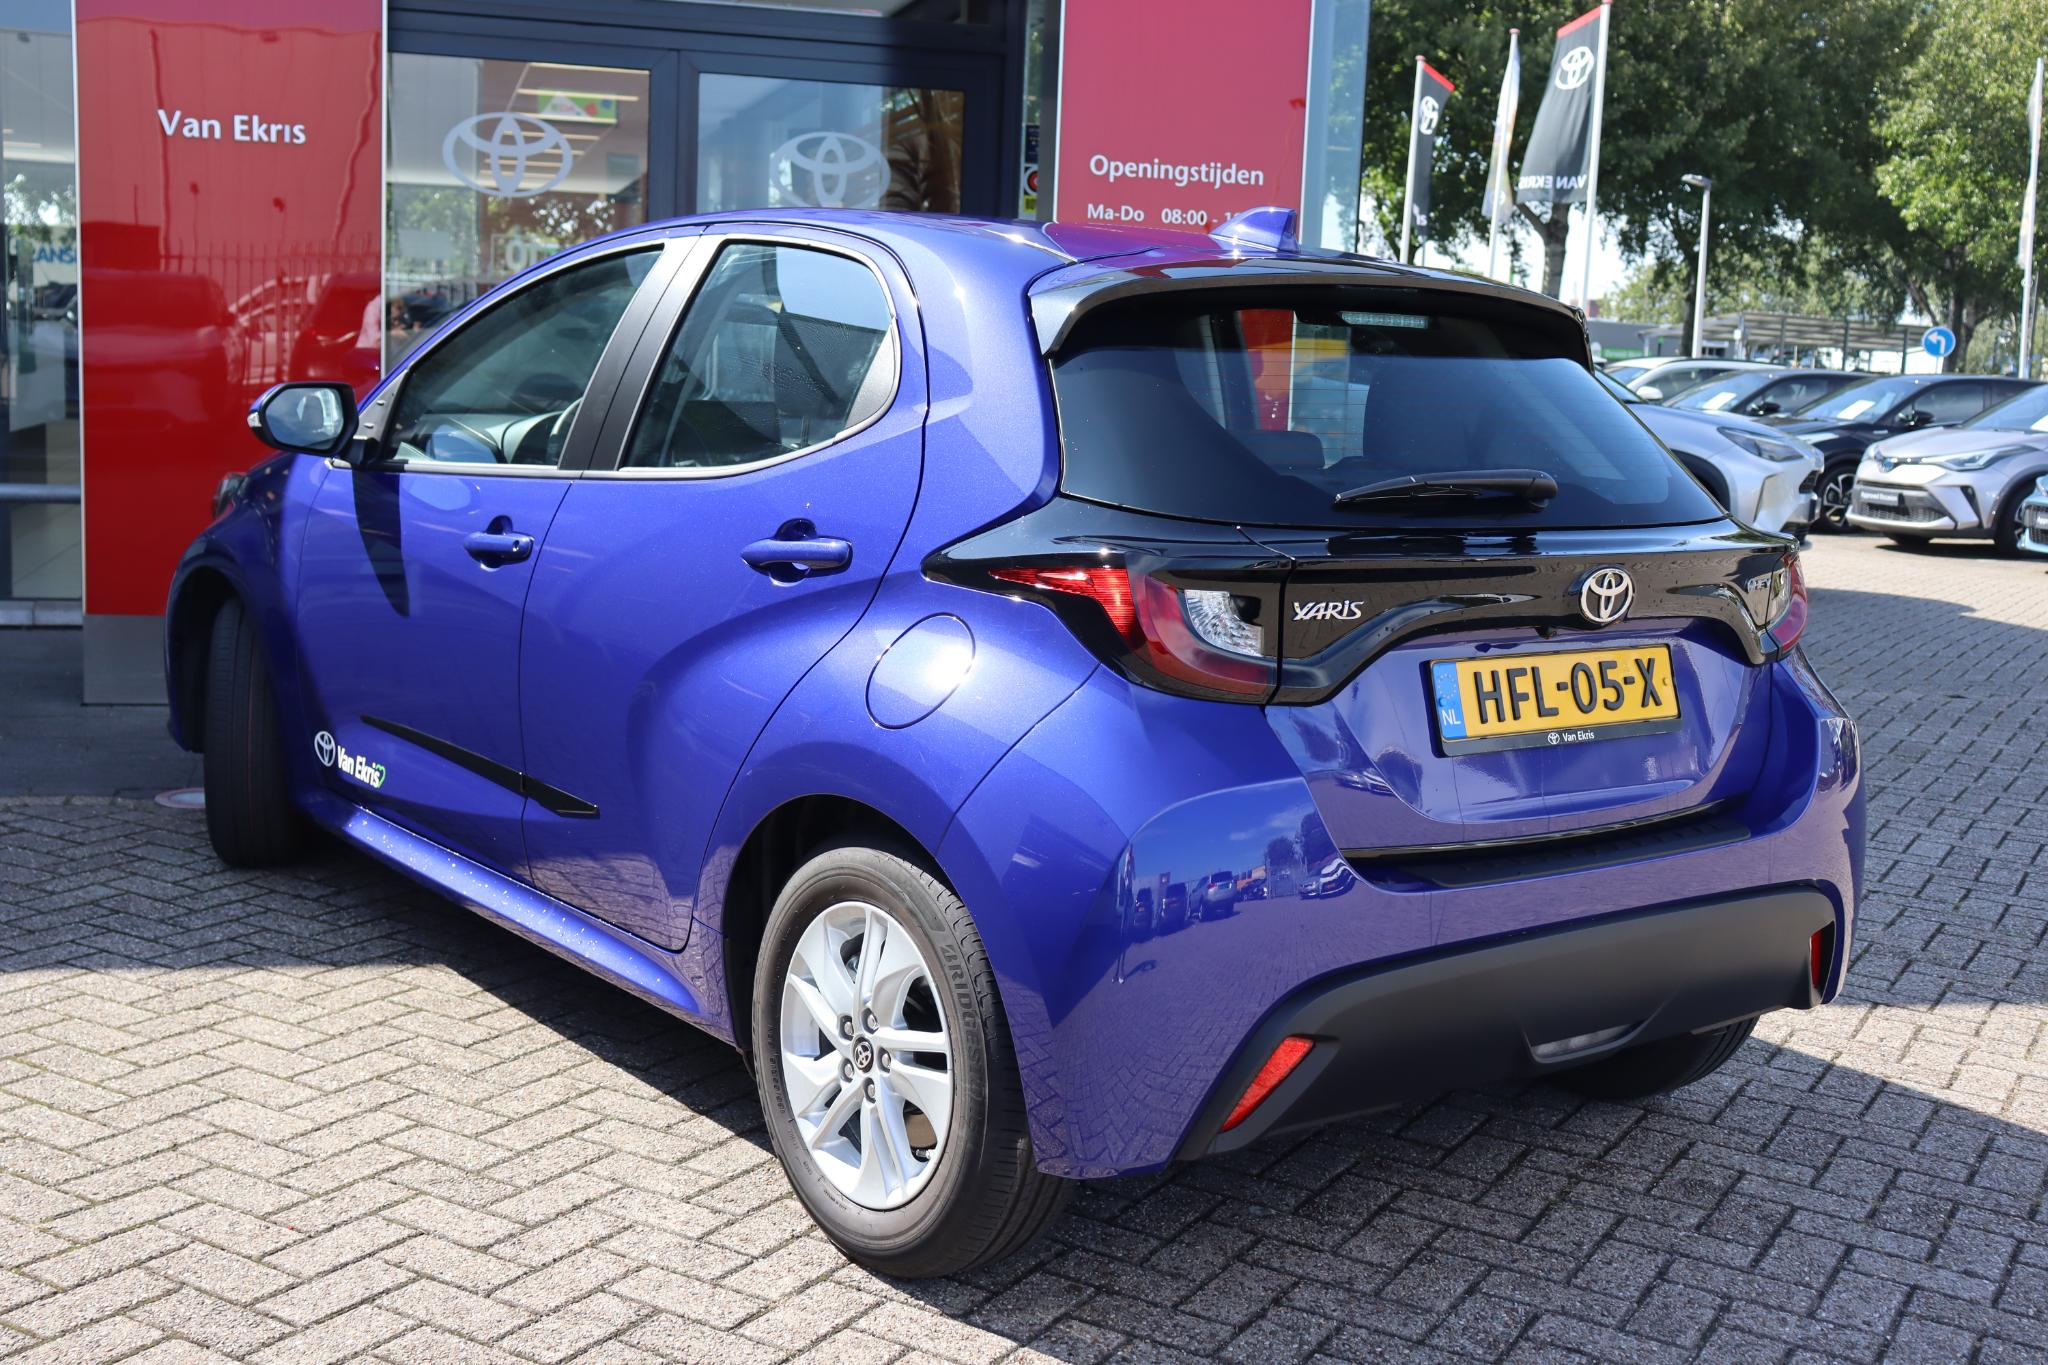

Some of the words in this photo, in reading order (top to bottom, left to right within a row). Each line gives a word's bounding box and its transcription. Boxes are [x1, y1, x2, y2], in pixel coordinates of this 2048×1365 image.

[157, 108, 222, 140] Van
[233, 114, 306, 145] Ekris
[1089, 154, 1265, 190] Openingstijden
[1087, 203, 1145, 222] Ma-Do
[1161, 208, 1208, 226] 08:00
[1473, 657, 1663, 725] HFL-05-X
[1442, 708, 1462, 726] NL
[1562, 732, 1577, 742] Van
[1578, 730, 1595, 741] Ekris
[337, 745, 355, 775] Van
[355, 755, 380, 788] Ekris
